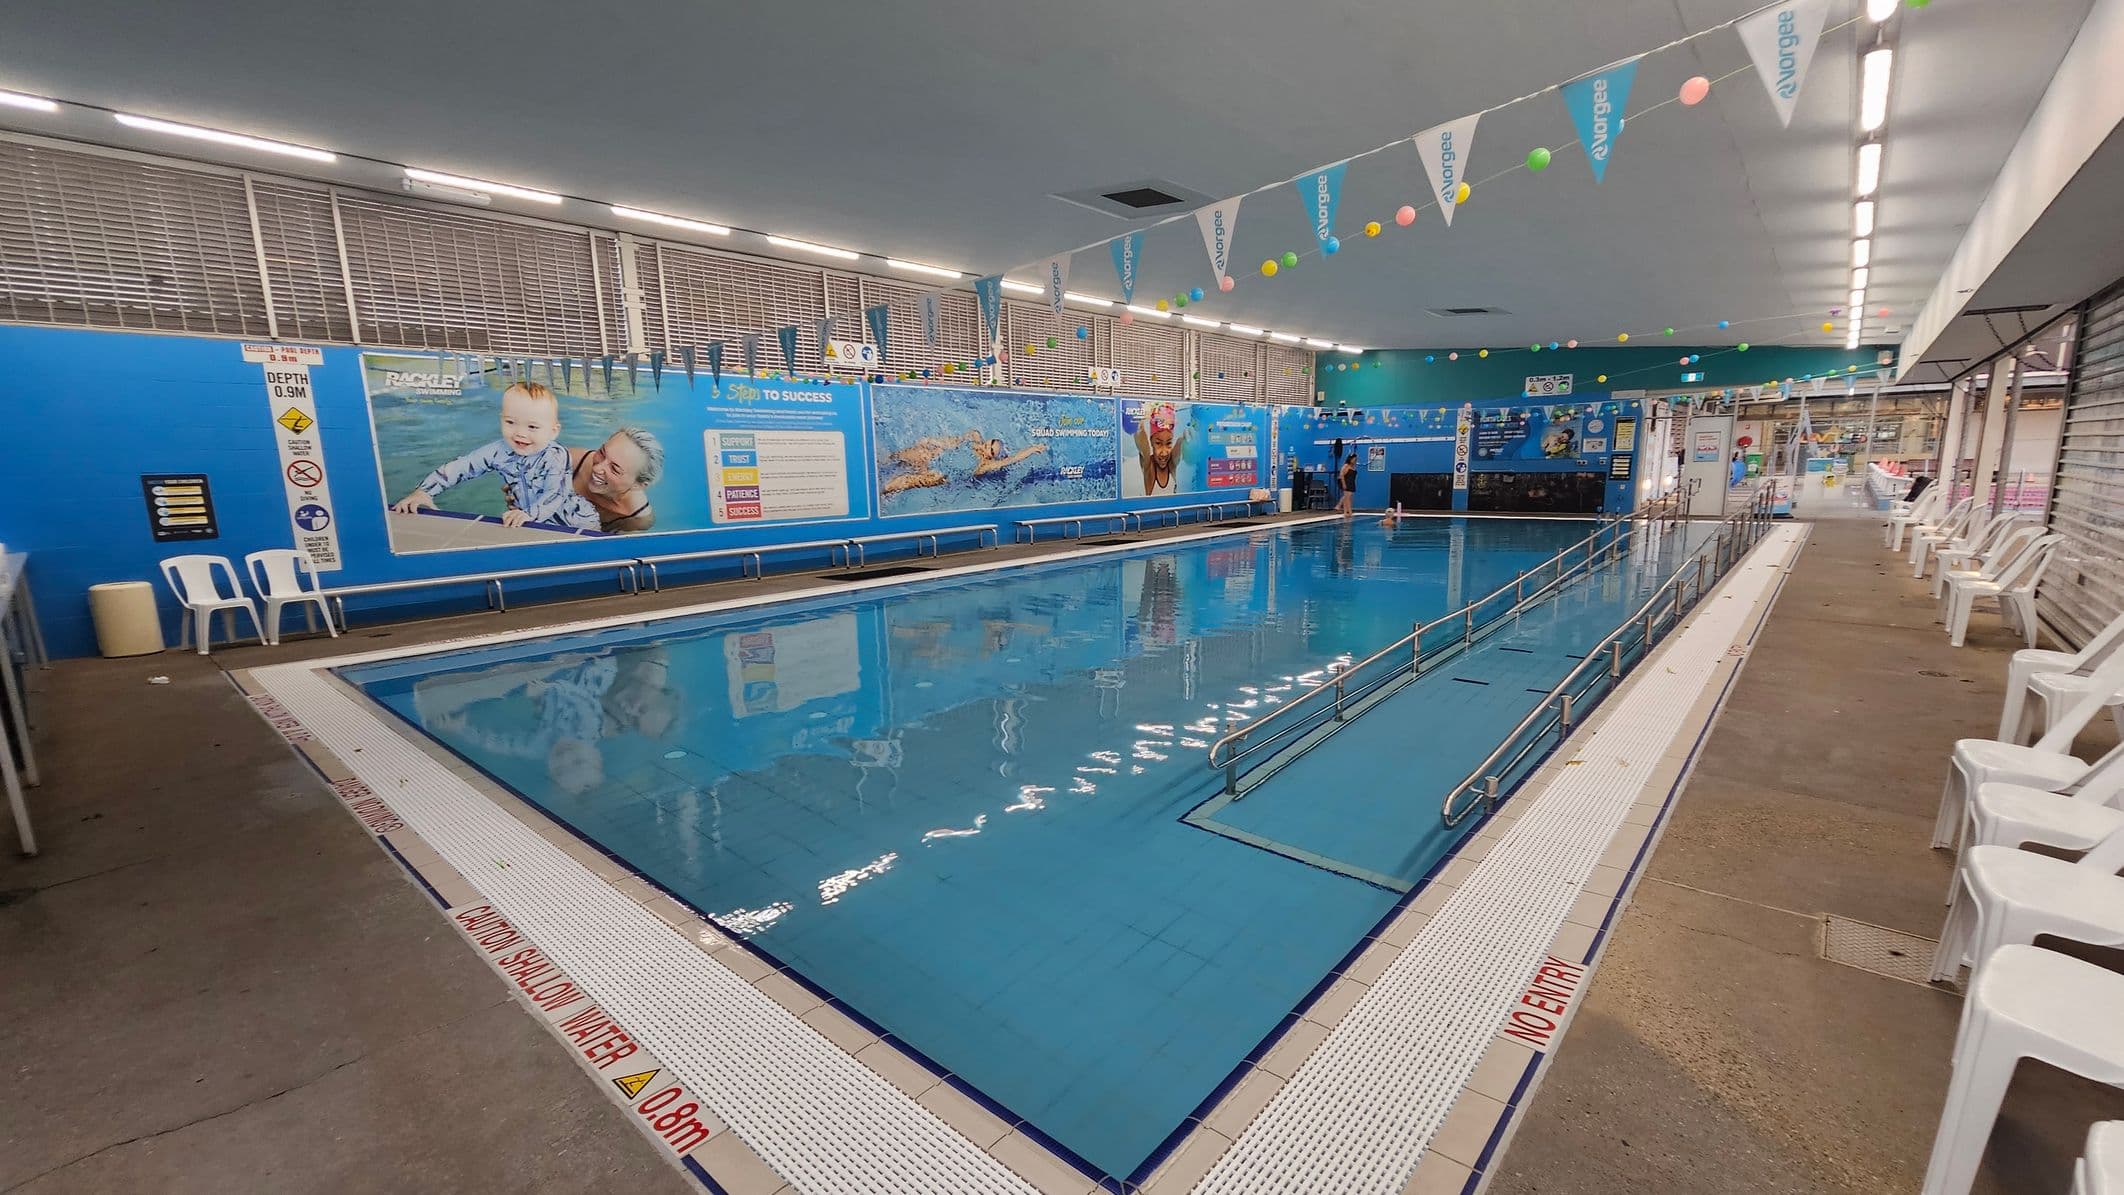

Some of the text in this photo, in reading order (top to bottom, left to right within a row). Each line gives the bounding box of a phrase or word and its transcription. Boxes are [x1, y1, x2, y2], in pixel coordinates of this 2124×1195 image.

[267, 372, 309, 384] DEPTH
[385, 371, 465, 389] RACKLEY
[275, 386, 307, 398] 0.9M
[416, 388, 462, 396] SWIMMING
[763, 389, 780, 401] TO
[782, 391, 833, 403] SUCCESS
[1032, 428, 1054, 437] SQUAD
[1055, 429, 1088, 438] SWIMMING
[721, 436, 755, 447] SUPPORT
[728, 454, 751, 464] TRUST
[726, 489, 760, 500] PATIENCE
[728, 506, 760, 517] SUCCESS
[1503, 955, 1584, 1047] NO ENTRY
[455, 905, 710, 1154] CAUTION SHALLOW WATER 0.8m
